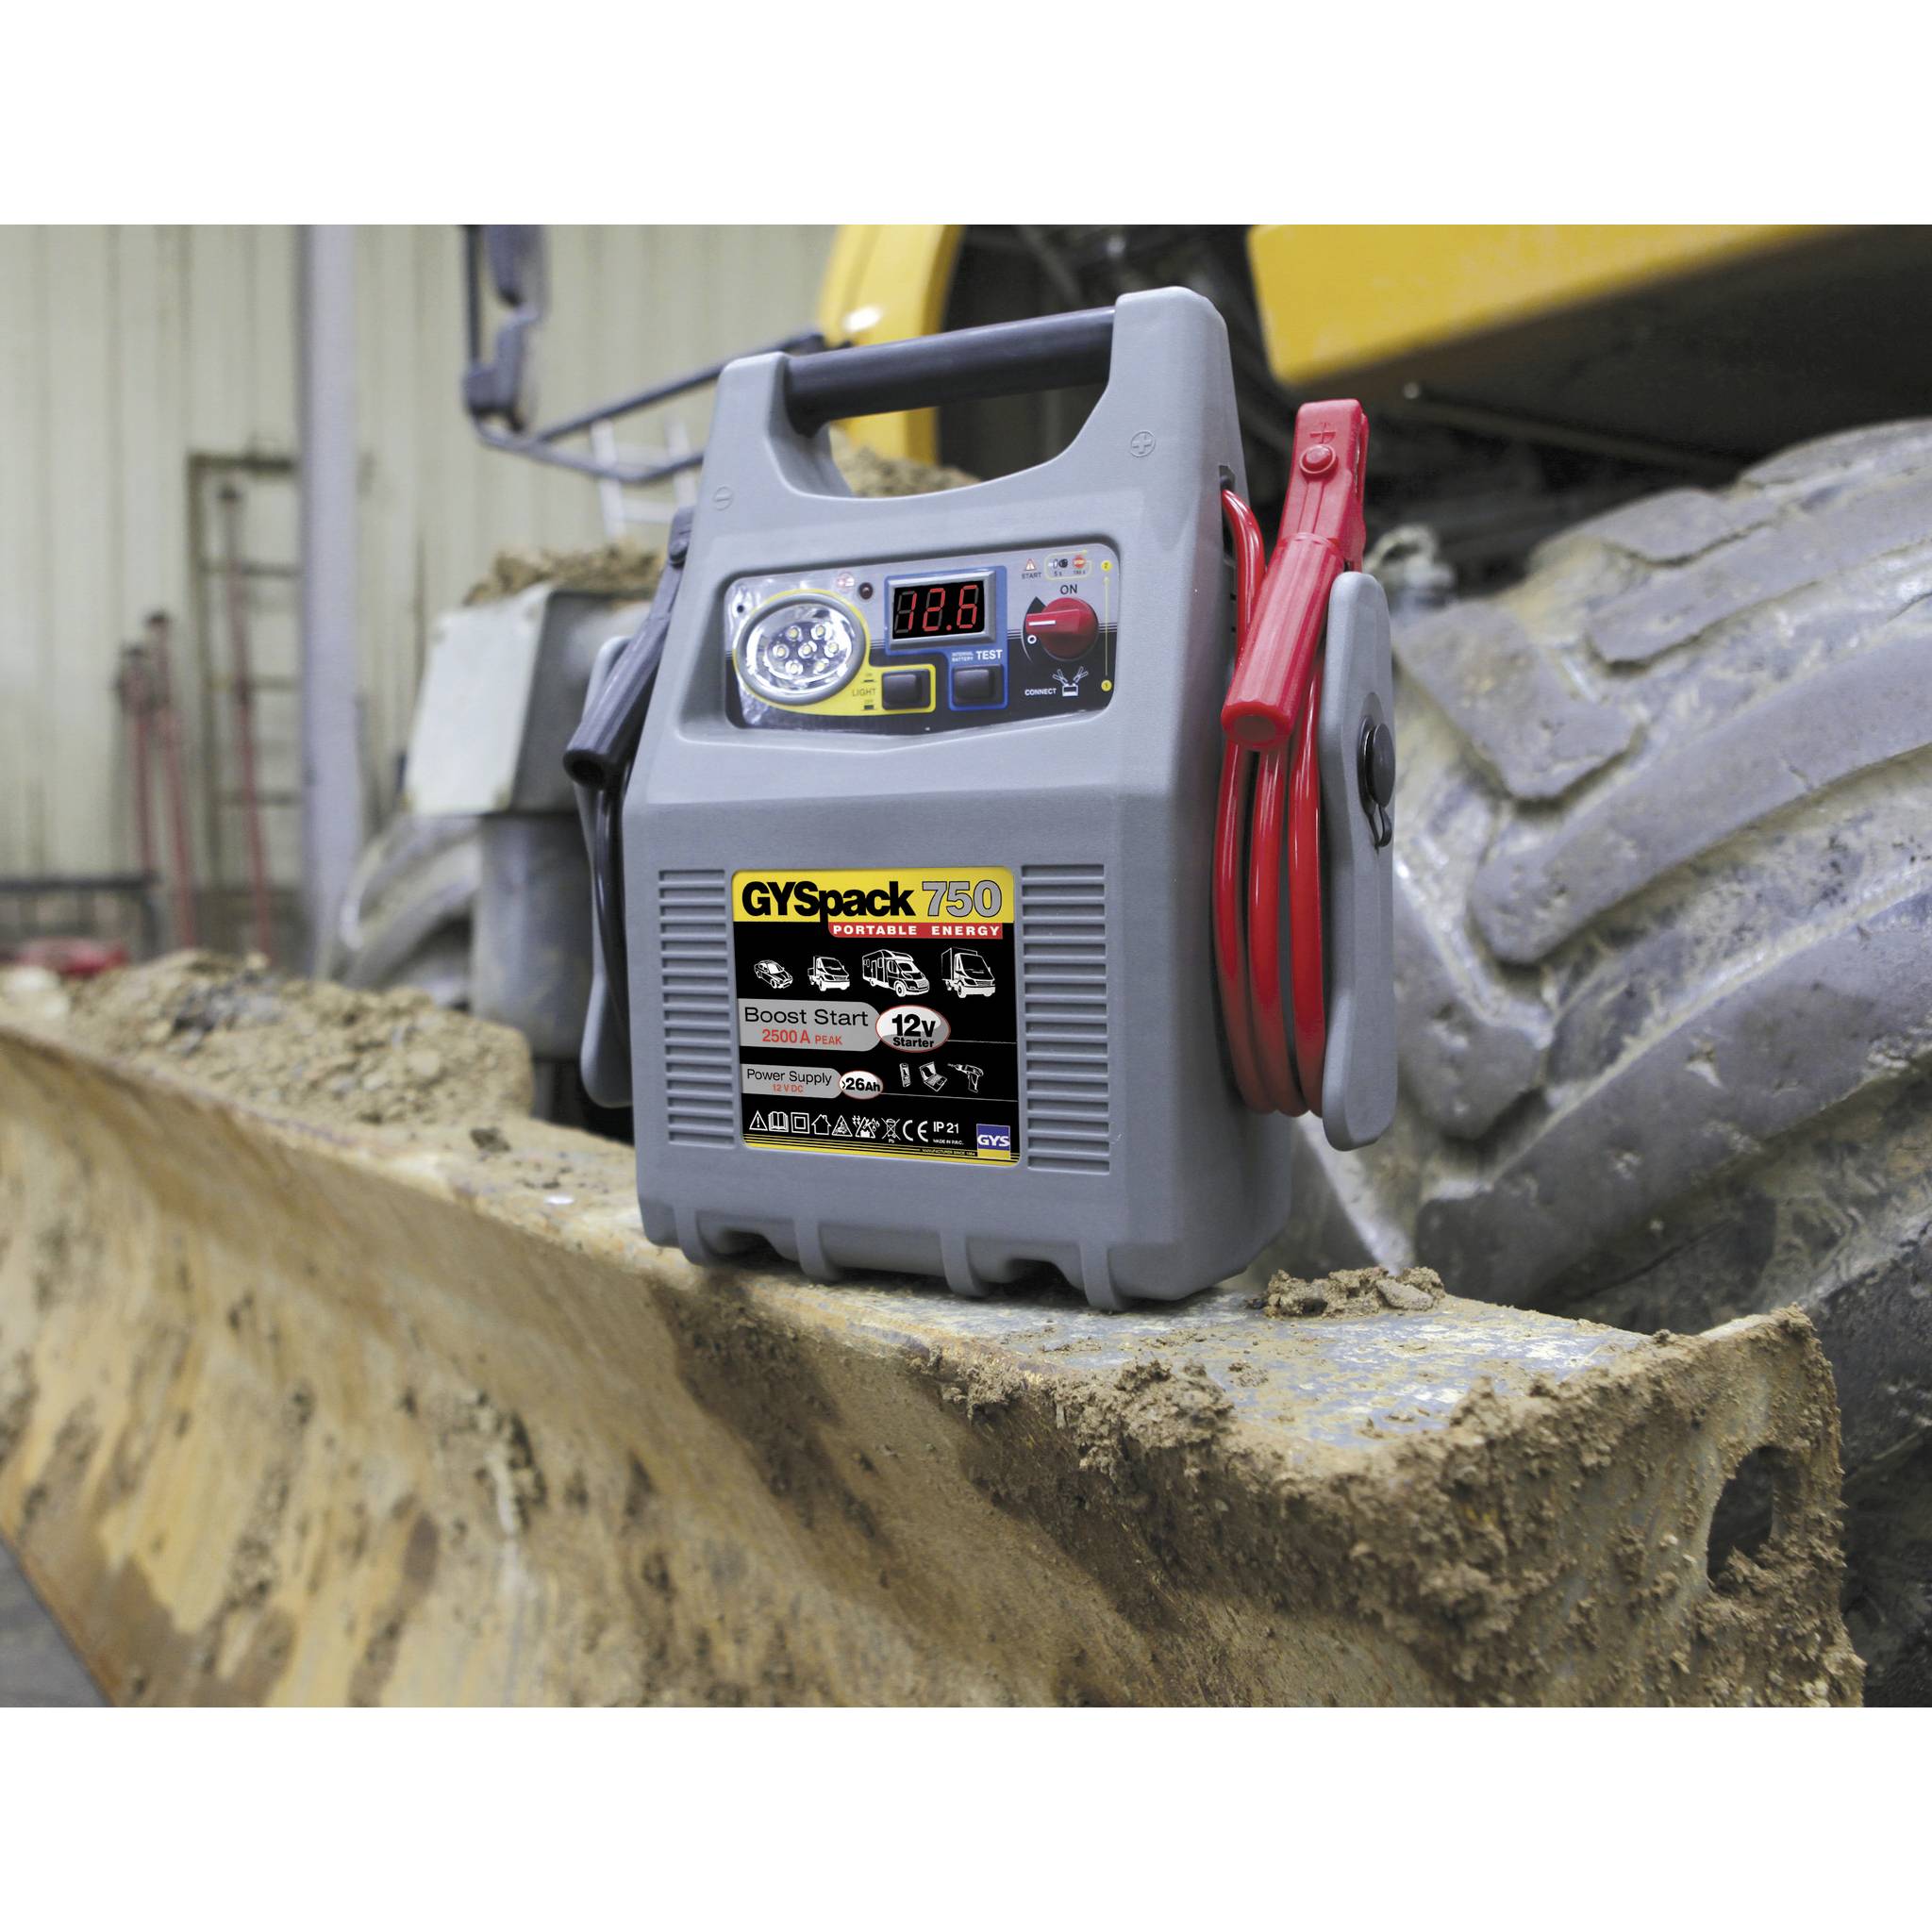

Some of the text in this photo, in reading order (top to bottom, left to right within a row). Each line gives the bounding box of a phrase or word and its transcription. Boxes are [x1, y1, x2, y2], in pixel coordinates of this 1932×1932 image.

[1059, 584, 1078, 595] ON
[908, 585, 978, 631] 12.6
[975, 649, 1003, 660] TEST
[852, 689, 876, 697] LIGHT
[1024, 688, 1057, 696] CONNECT
[741, 879, 1003, 924] GYSpack 750
[833, 924, 1001, 936] PORTABLE ENERGY
[744, 1007, 869, 1026] Boost Start
[762, 1029, 843, 1045] 2500 A PEAK
[892, 1037, 935, 1048] Starter
[746, 1069, 832, 1086] Power Supply
[933, 1121, 959, 1134] IP 21
[977, 1134, 1011, 1147] GYS
